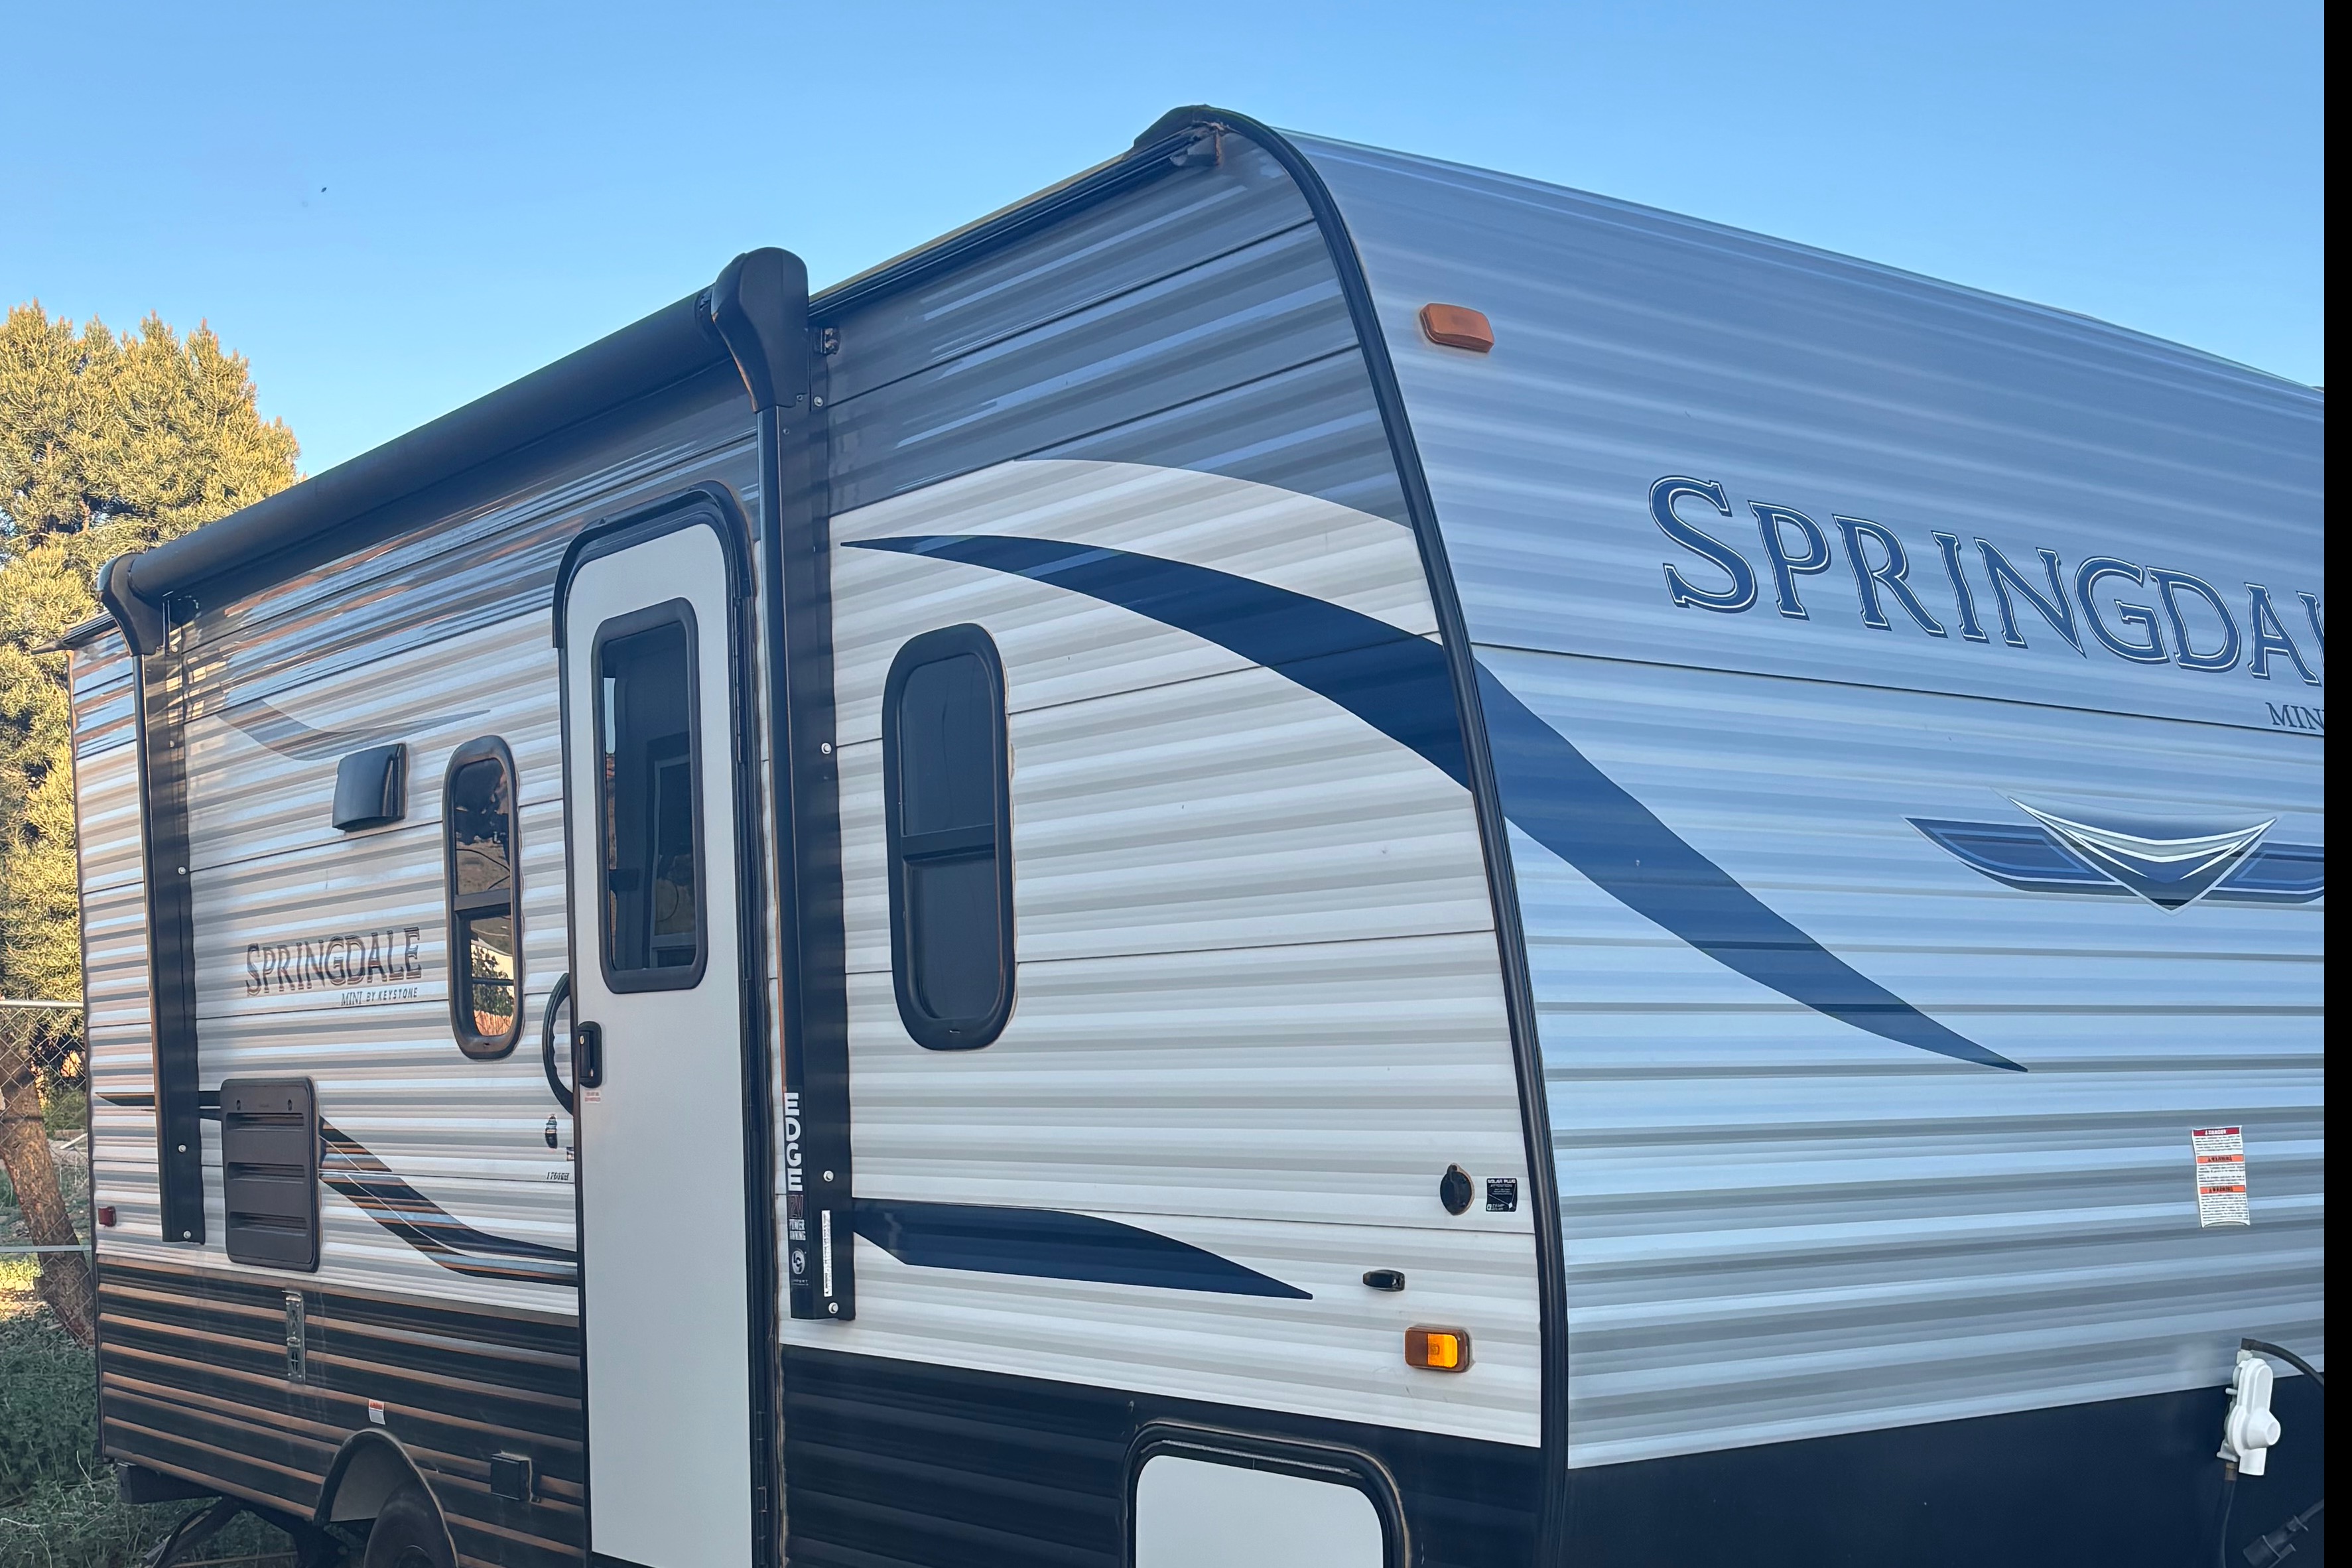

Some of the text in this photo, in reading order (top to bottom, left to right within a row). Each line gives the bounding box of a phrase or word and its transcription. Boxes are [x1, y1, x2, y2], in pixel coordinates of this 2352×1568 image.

[2264, 702, 2324, 730] MIN
[245, 927, 421, 996] SPRINGDALE
[341, 987, 418, 1006] MINI BY KEYSTONE
[784, 1092, 803, 1191] EDGE
